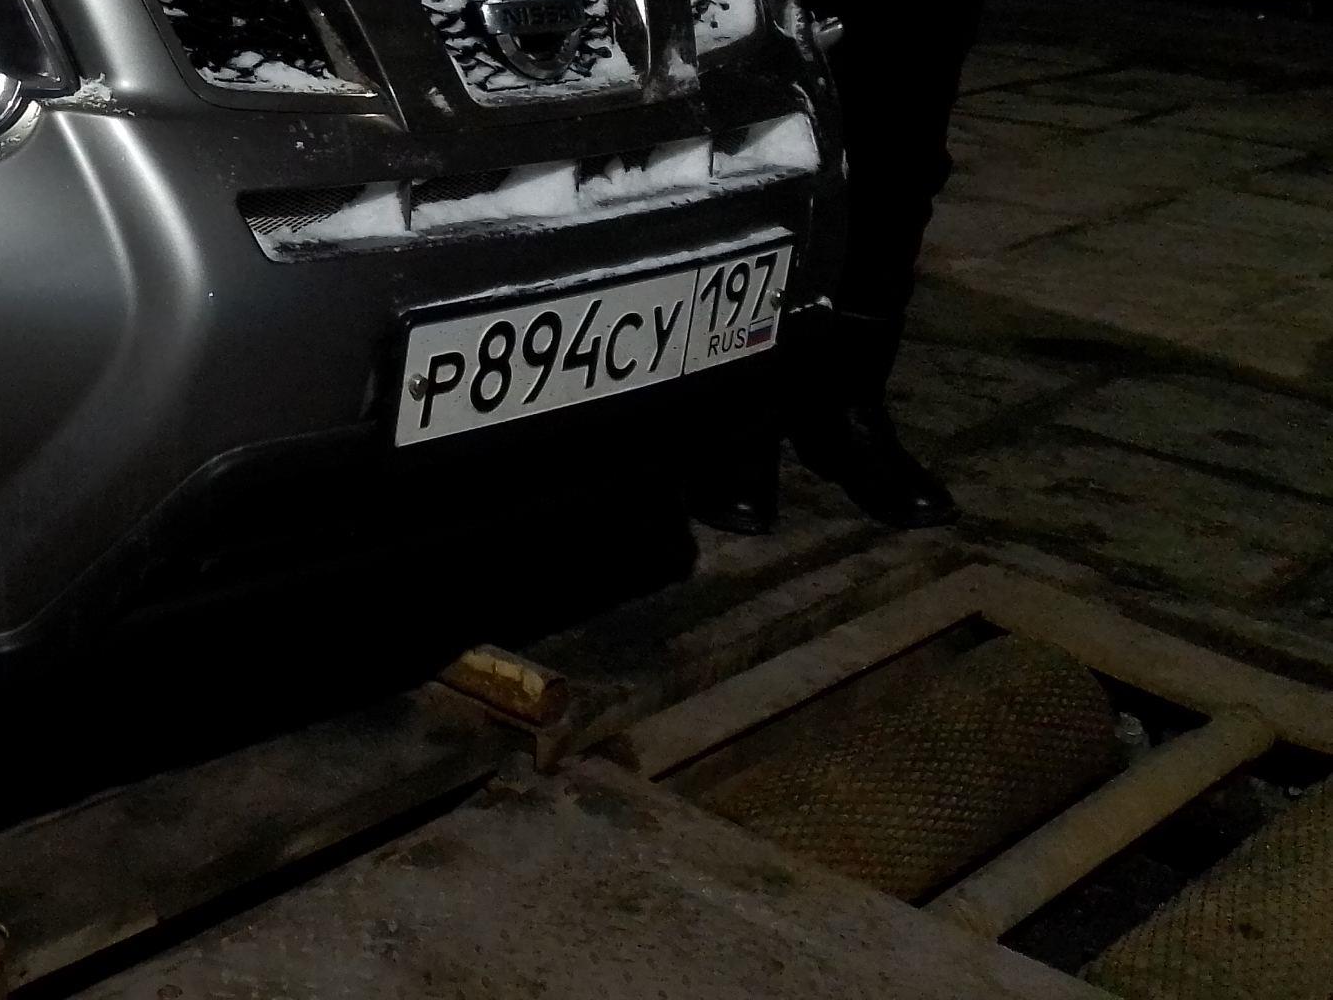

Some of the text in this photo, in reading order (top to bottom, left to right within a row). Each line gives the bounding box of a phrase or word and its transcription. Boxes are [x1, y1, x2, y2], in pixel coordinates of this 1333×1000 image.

[419, 251, 779, 429] Р894СУ 197
[707, 327, 747, 358] RUS
